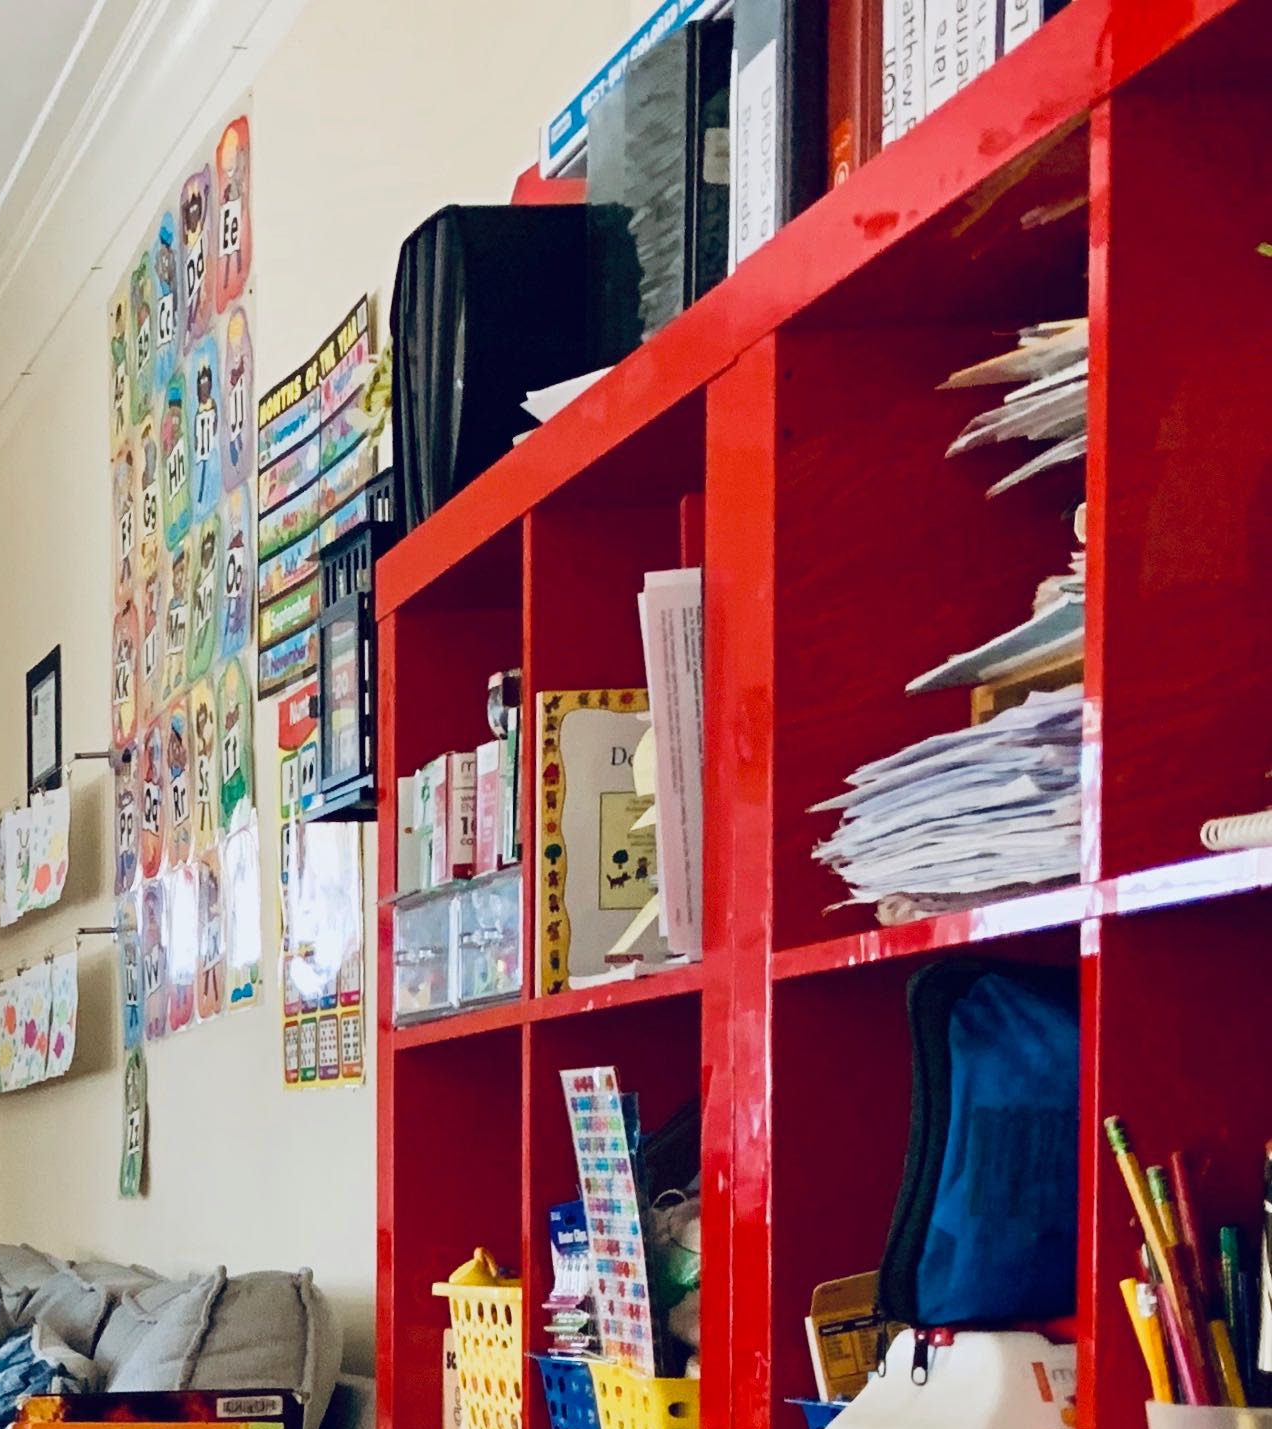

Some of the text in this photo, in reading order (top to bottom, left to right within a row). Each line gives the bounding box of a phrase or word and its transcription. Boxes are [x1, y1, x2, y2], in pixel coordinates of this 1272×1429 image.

[223, 209, 238, 249] Ee
[187, 239, 205, 297] Dd
[259, 374, 302, 427] MONTHS
[168, 455, 186, 494] Hh
[226, 554, 243, 594] Oo
[114, 666, 130, 699] Kk
[224, 735, 238, 776] Tt
[172, 784, 186, 822] Rr
